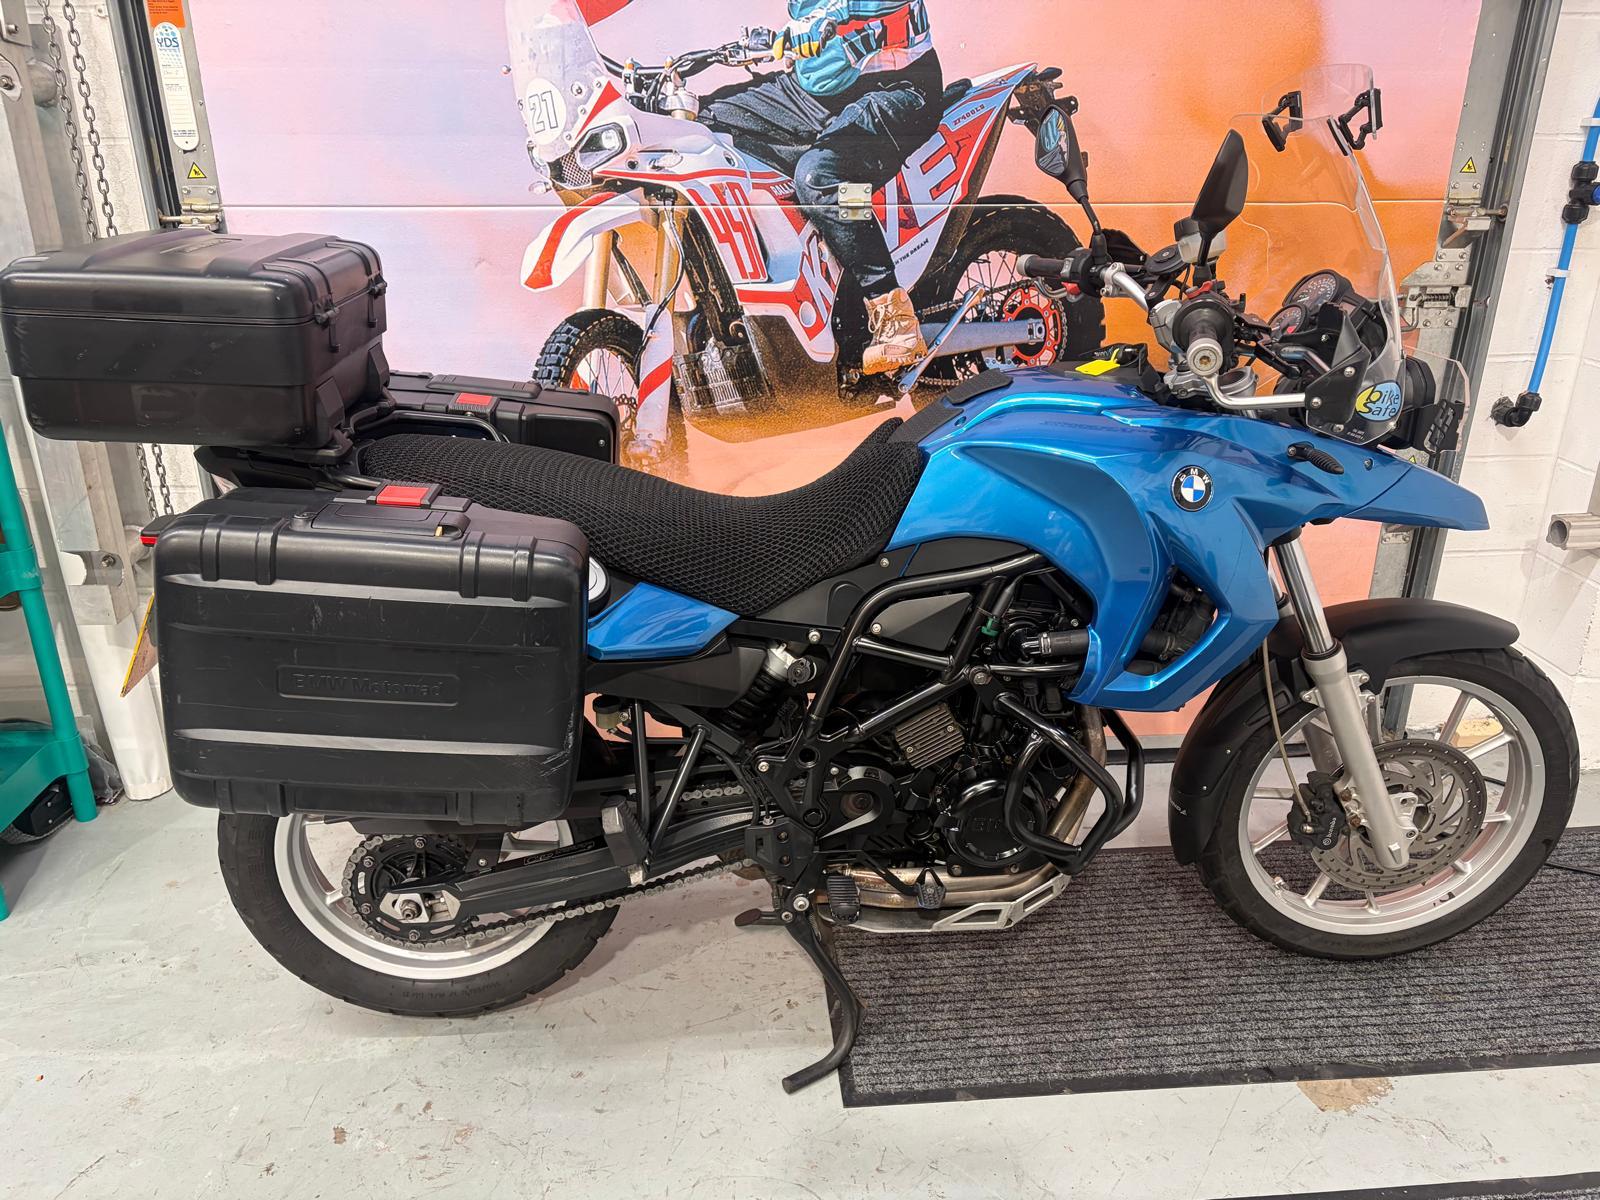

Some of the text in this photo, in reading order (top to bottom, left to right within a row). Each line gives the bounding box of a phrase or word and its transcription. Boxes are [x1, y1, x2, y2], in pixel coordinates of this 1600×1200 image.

[156, 37, 180, 48] YDS
[528, 91, 559, 135] 21
[910, 238, 929, 256] DREAM
[1366, 385, 1400, 406] bike
[292, 673, 446, 699] BMW Motorrad
